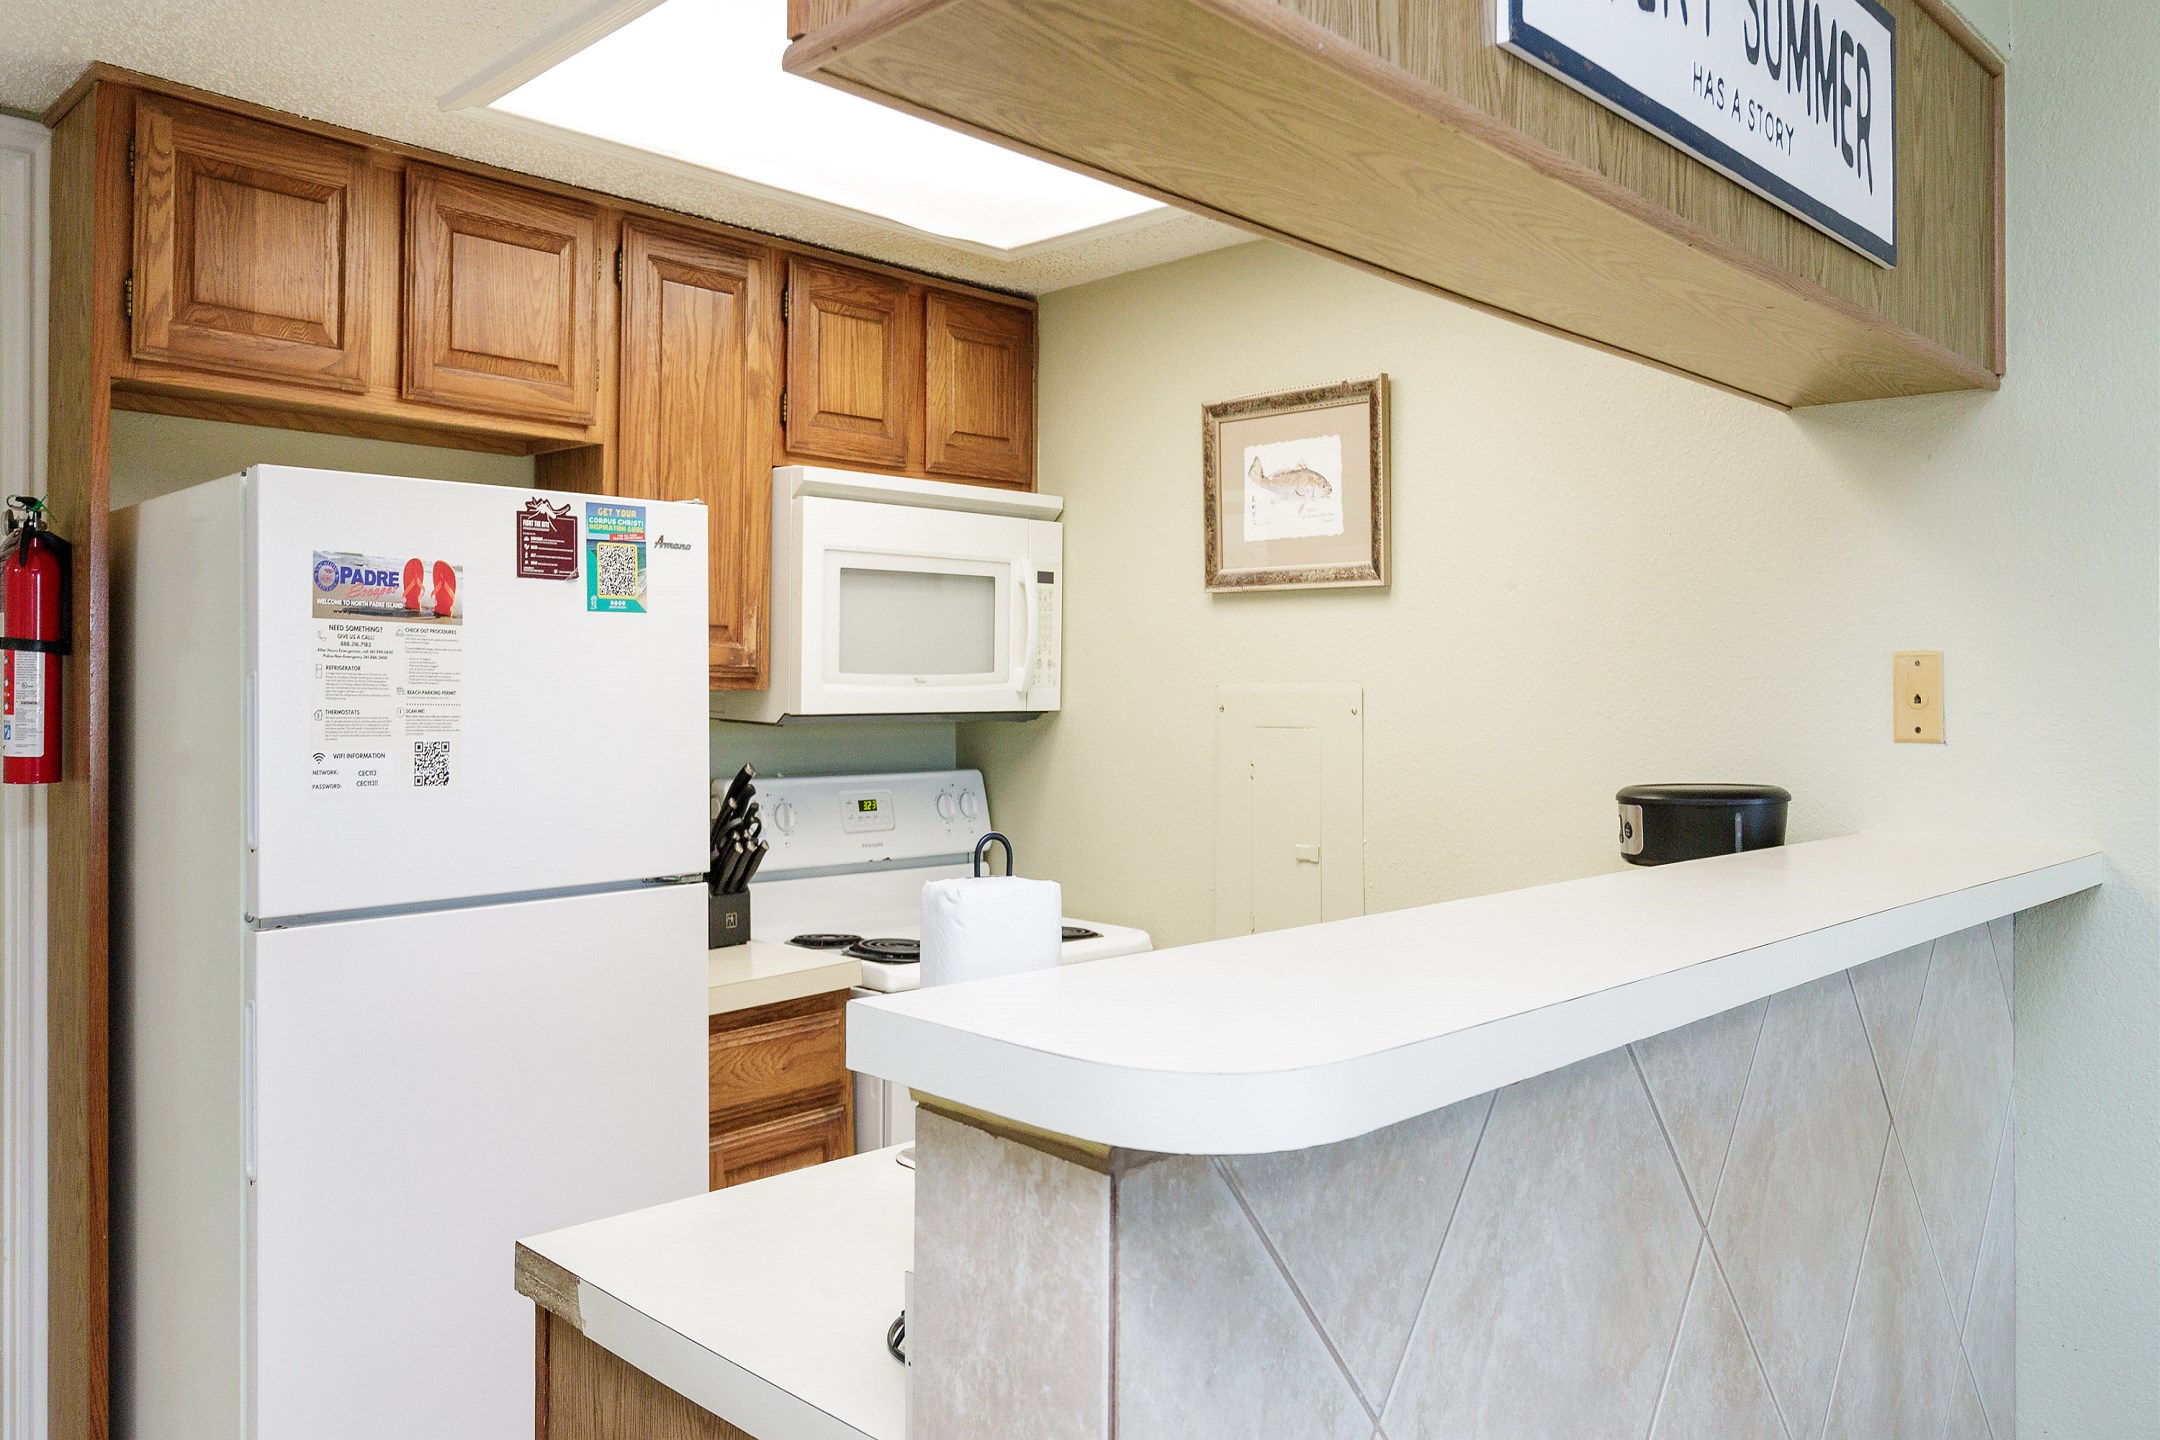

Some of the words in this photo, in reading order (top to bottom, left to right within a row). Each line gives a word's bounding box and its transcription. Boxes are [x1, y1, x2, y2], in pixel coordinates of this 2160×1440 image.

[1692, 61, 1725, 110] HAS
[1731, 88, 1741, 123] A
[1747, 98, 1794, 157] STORY
[597, 507, 613, 516] GET
[616, 508, 637, 518] YOUR
[588, 517, 616, 525] CORPUS
[617, 519, 644, 527] CHRISTI
[654, 535, 692, 551] Amana
[340, 566, 400, 587] PADRE
[347, 582, 400, 599] Escapes
[316, 598, 343, 606] WELCOME
[345, 625, 384, 633] SOMETHING?
